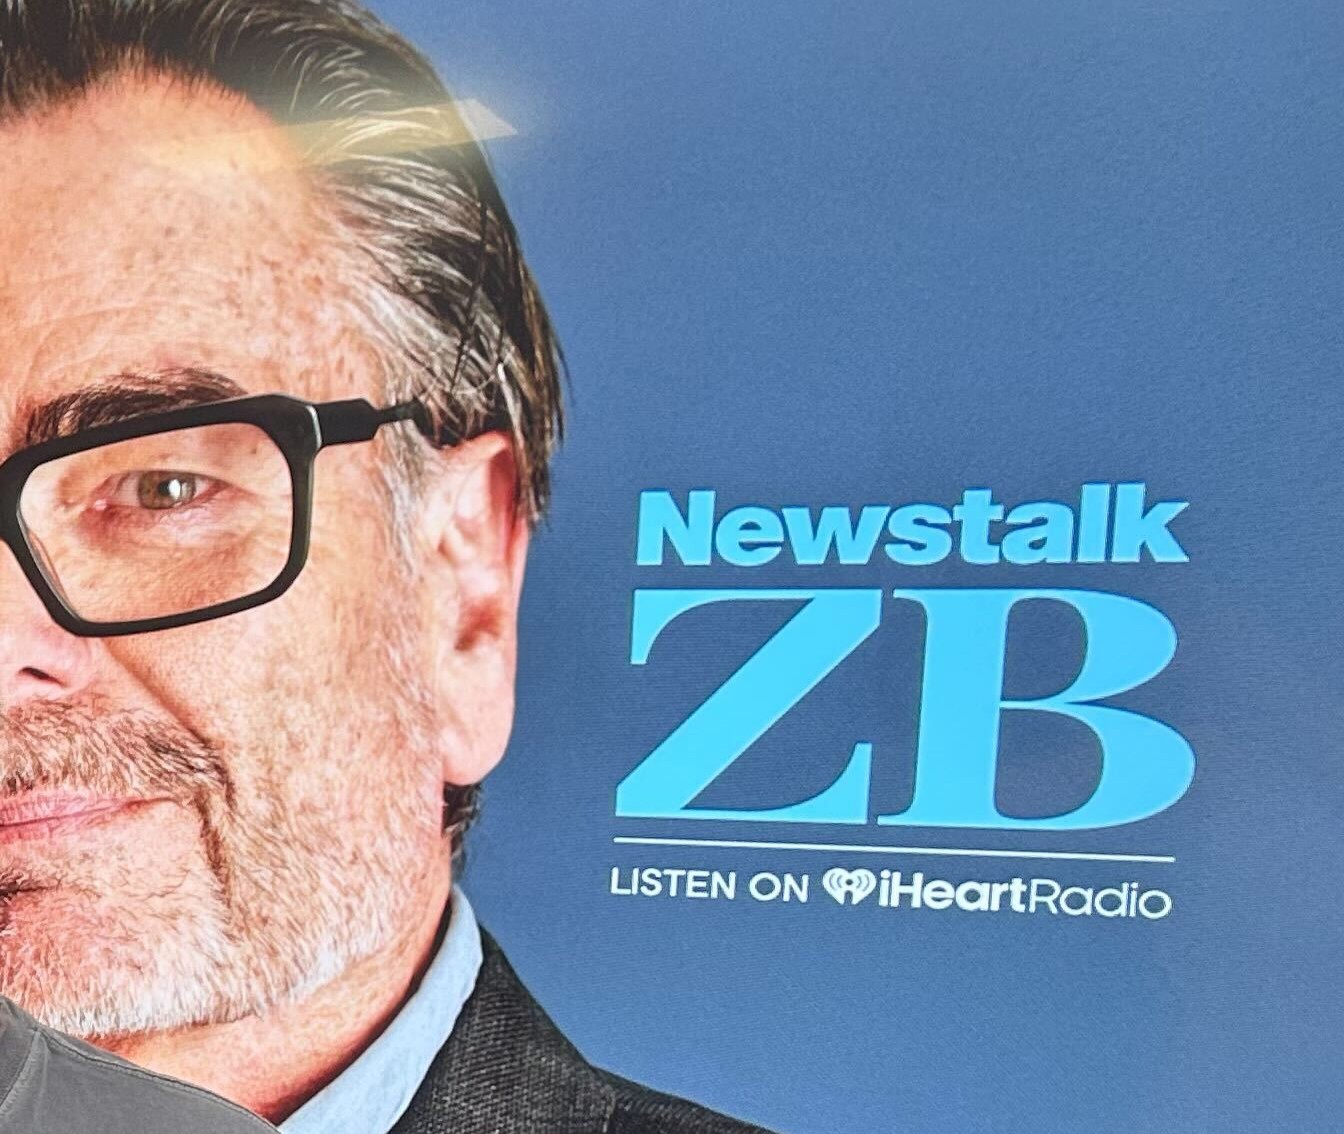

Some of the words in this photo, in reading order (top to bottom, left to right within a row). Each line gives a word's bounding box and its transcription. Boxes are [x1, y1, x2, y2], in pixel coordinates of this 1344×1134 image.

[637, 483, 1189, 566] Newstalk
[615, 589, 1195, 830] ZB
[611, 867, 736, 899] LISTEN
[749, 873, 809, 902] ON
[879, 870, 1172, 919] iHeartRadio
